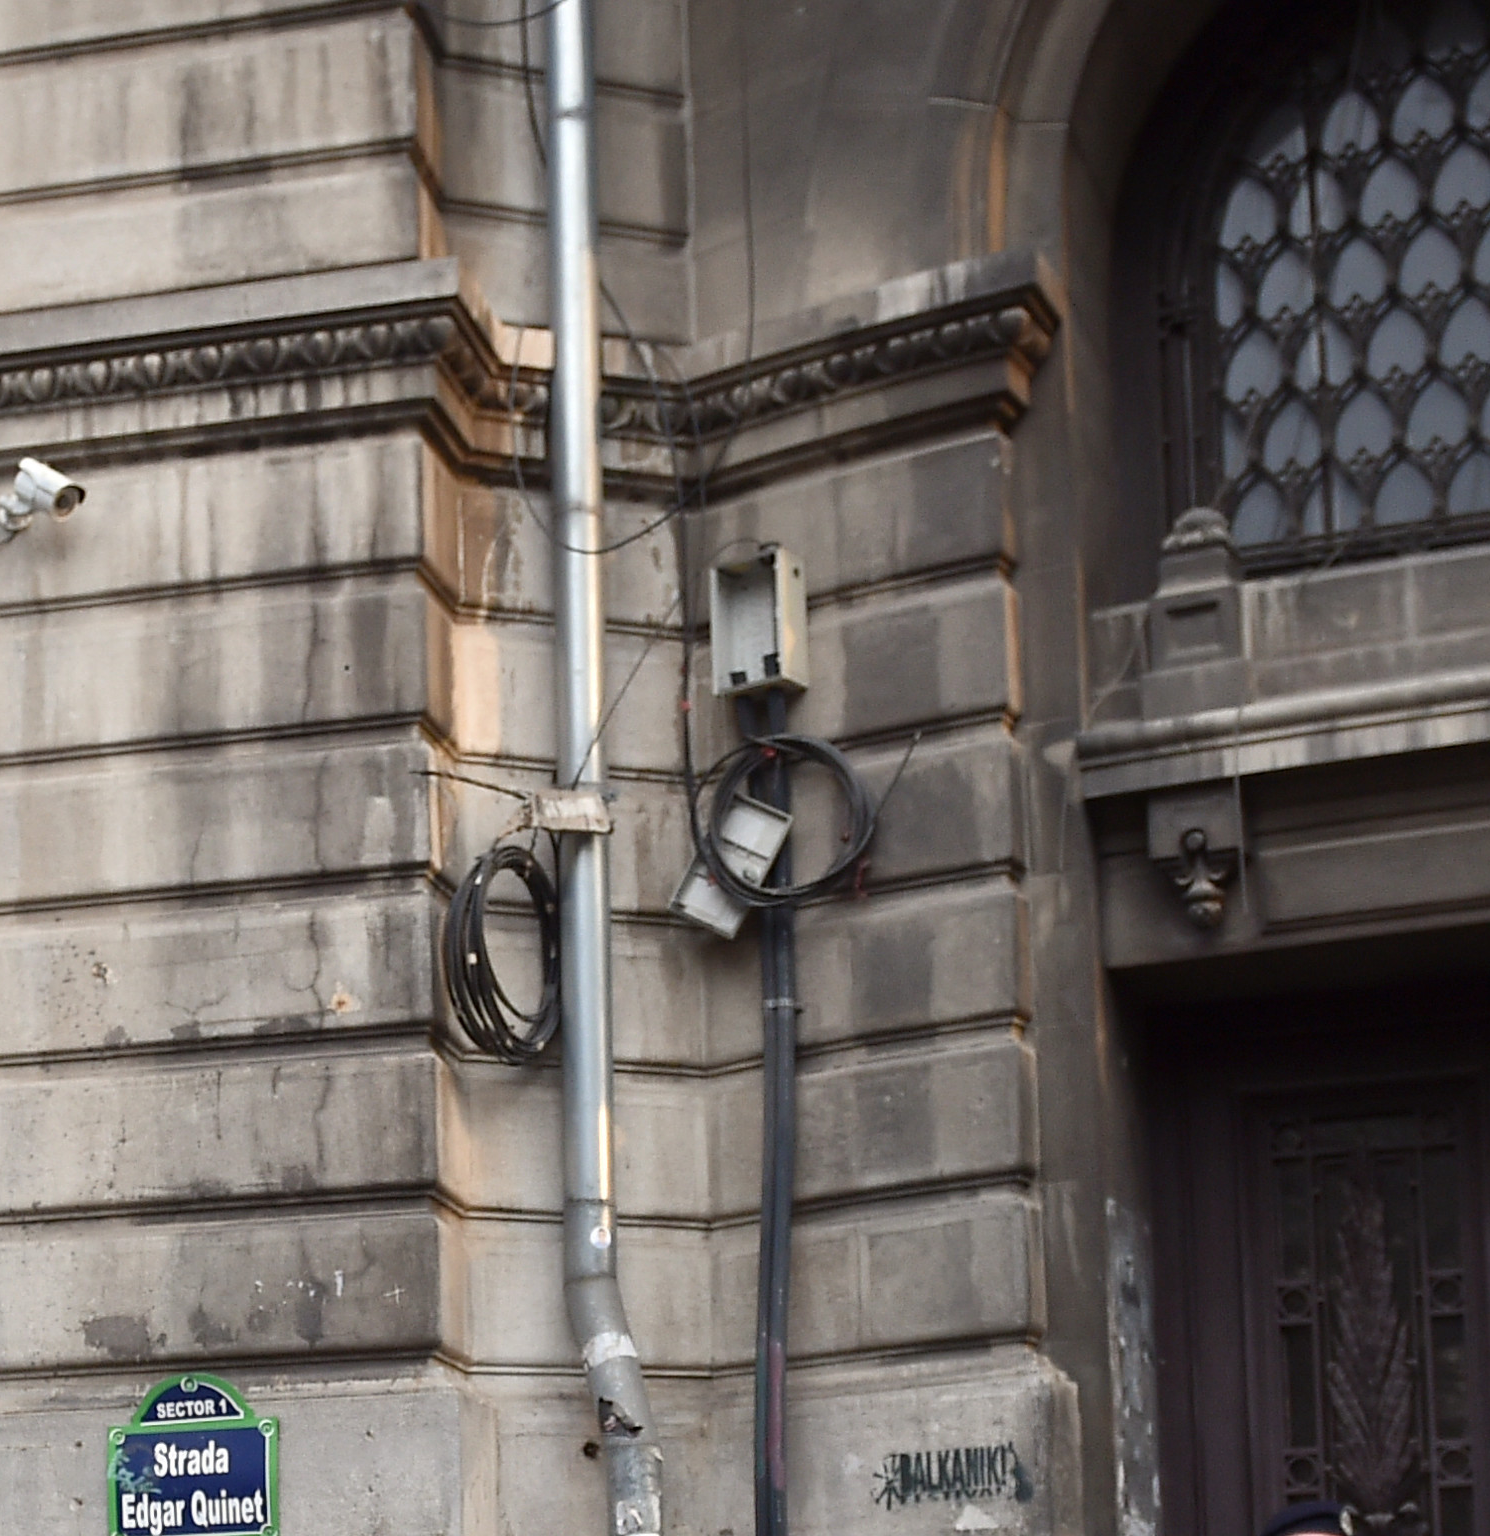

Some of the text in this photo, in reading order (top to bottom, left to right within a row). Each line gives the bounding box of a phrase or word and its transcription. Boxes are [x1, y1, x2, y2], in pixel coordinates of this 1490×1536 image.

[157, 1398, 227, 1418] SECTOR 1
[154, 1440, 229, 1477] Strada
[122, 1489, 264, 1536] Edgar Quinet
